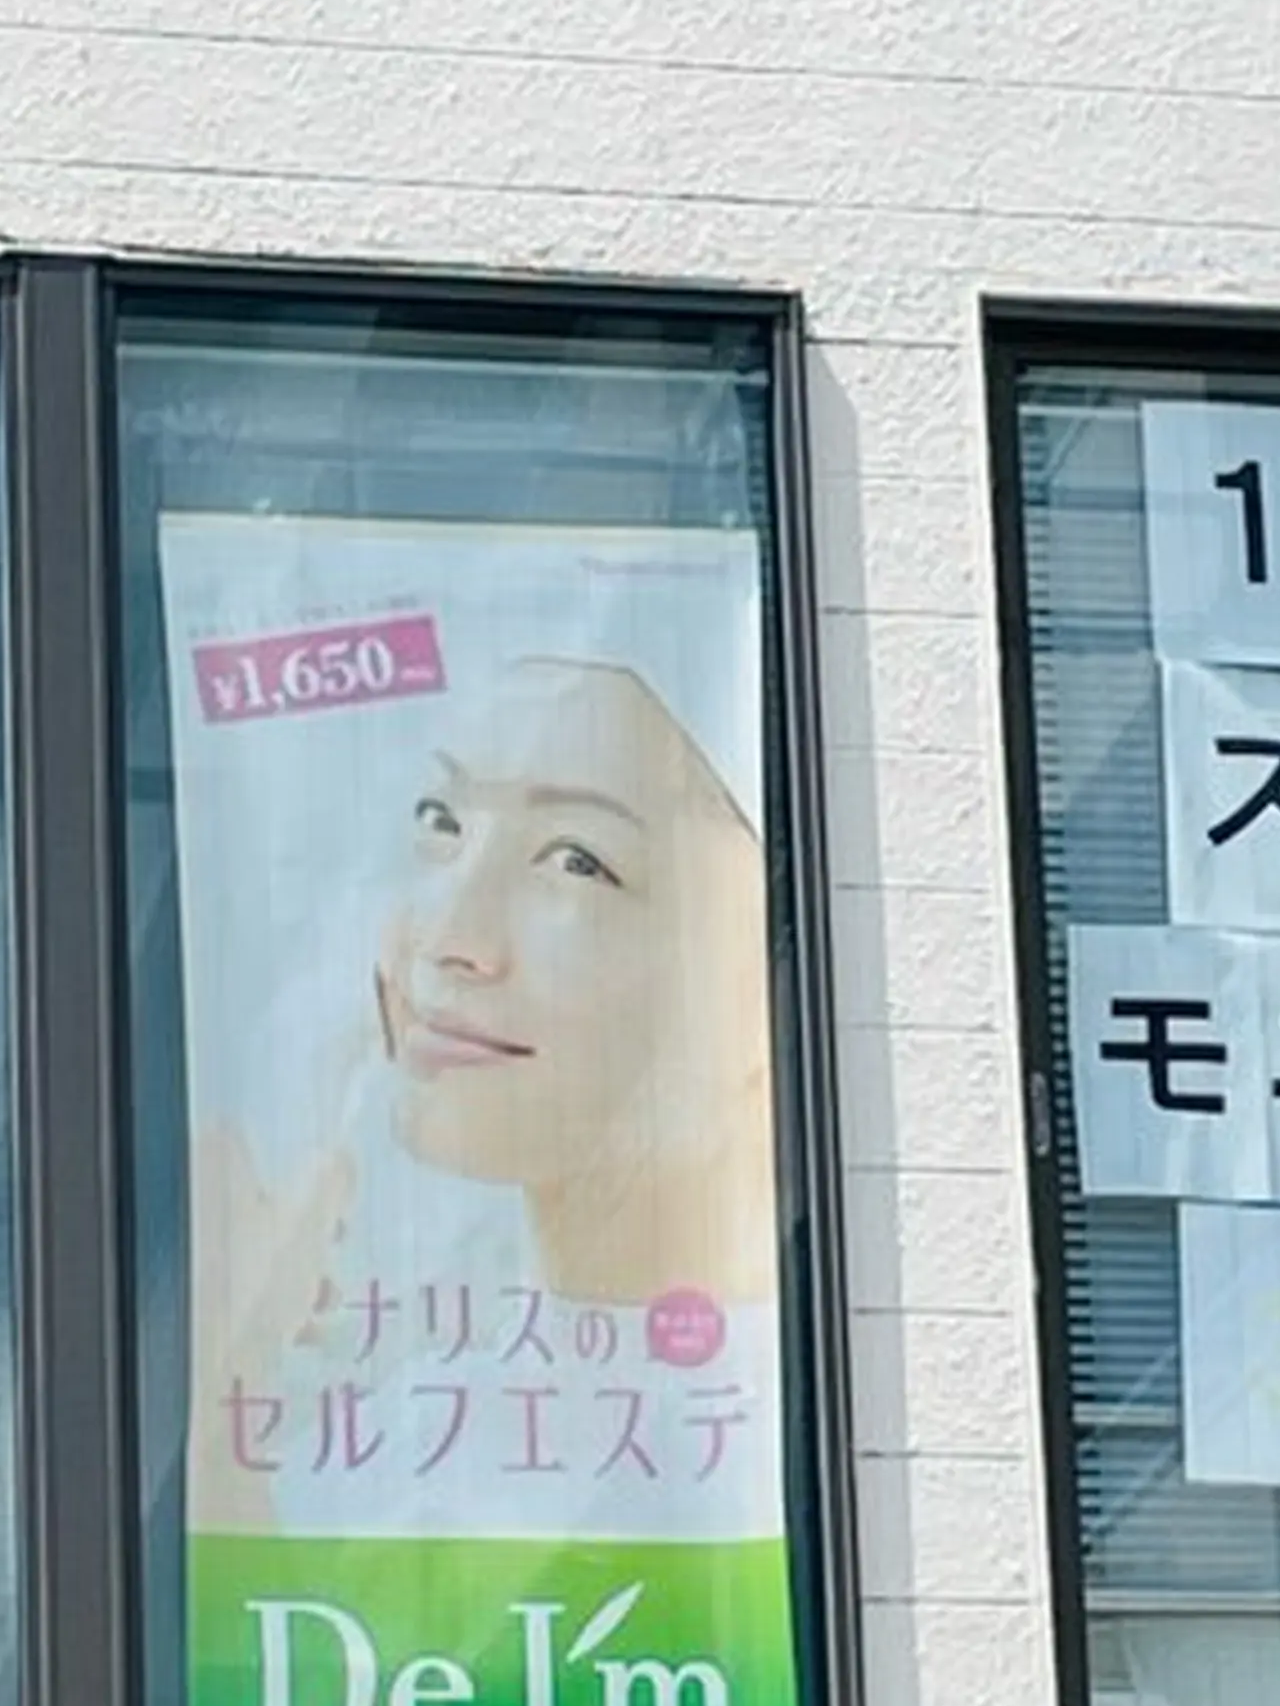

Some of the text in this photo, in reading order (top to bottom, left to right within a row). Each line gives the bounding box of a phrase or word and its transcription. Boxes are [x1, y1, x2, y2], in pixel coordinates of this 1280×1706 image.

[212, 636, 395, 712] ¥1,650
[346, 1278, 619, 1365] ナリスの
[219, 1376, 751, 1483] セルフエステ
